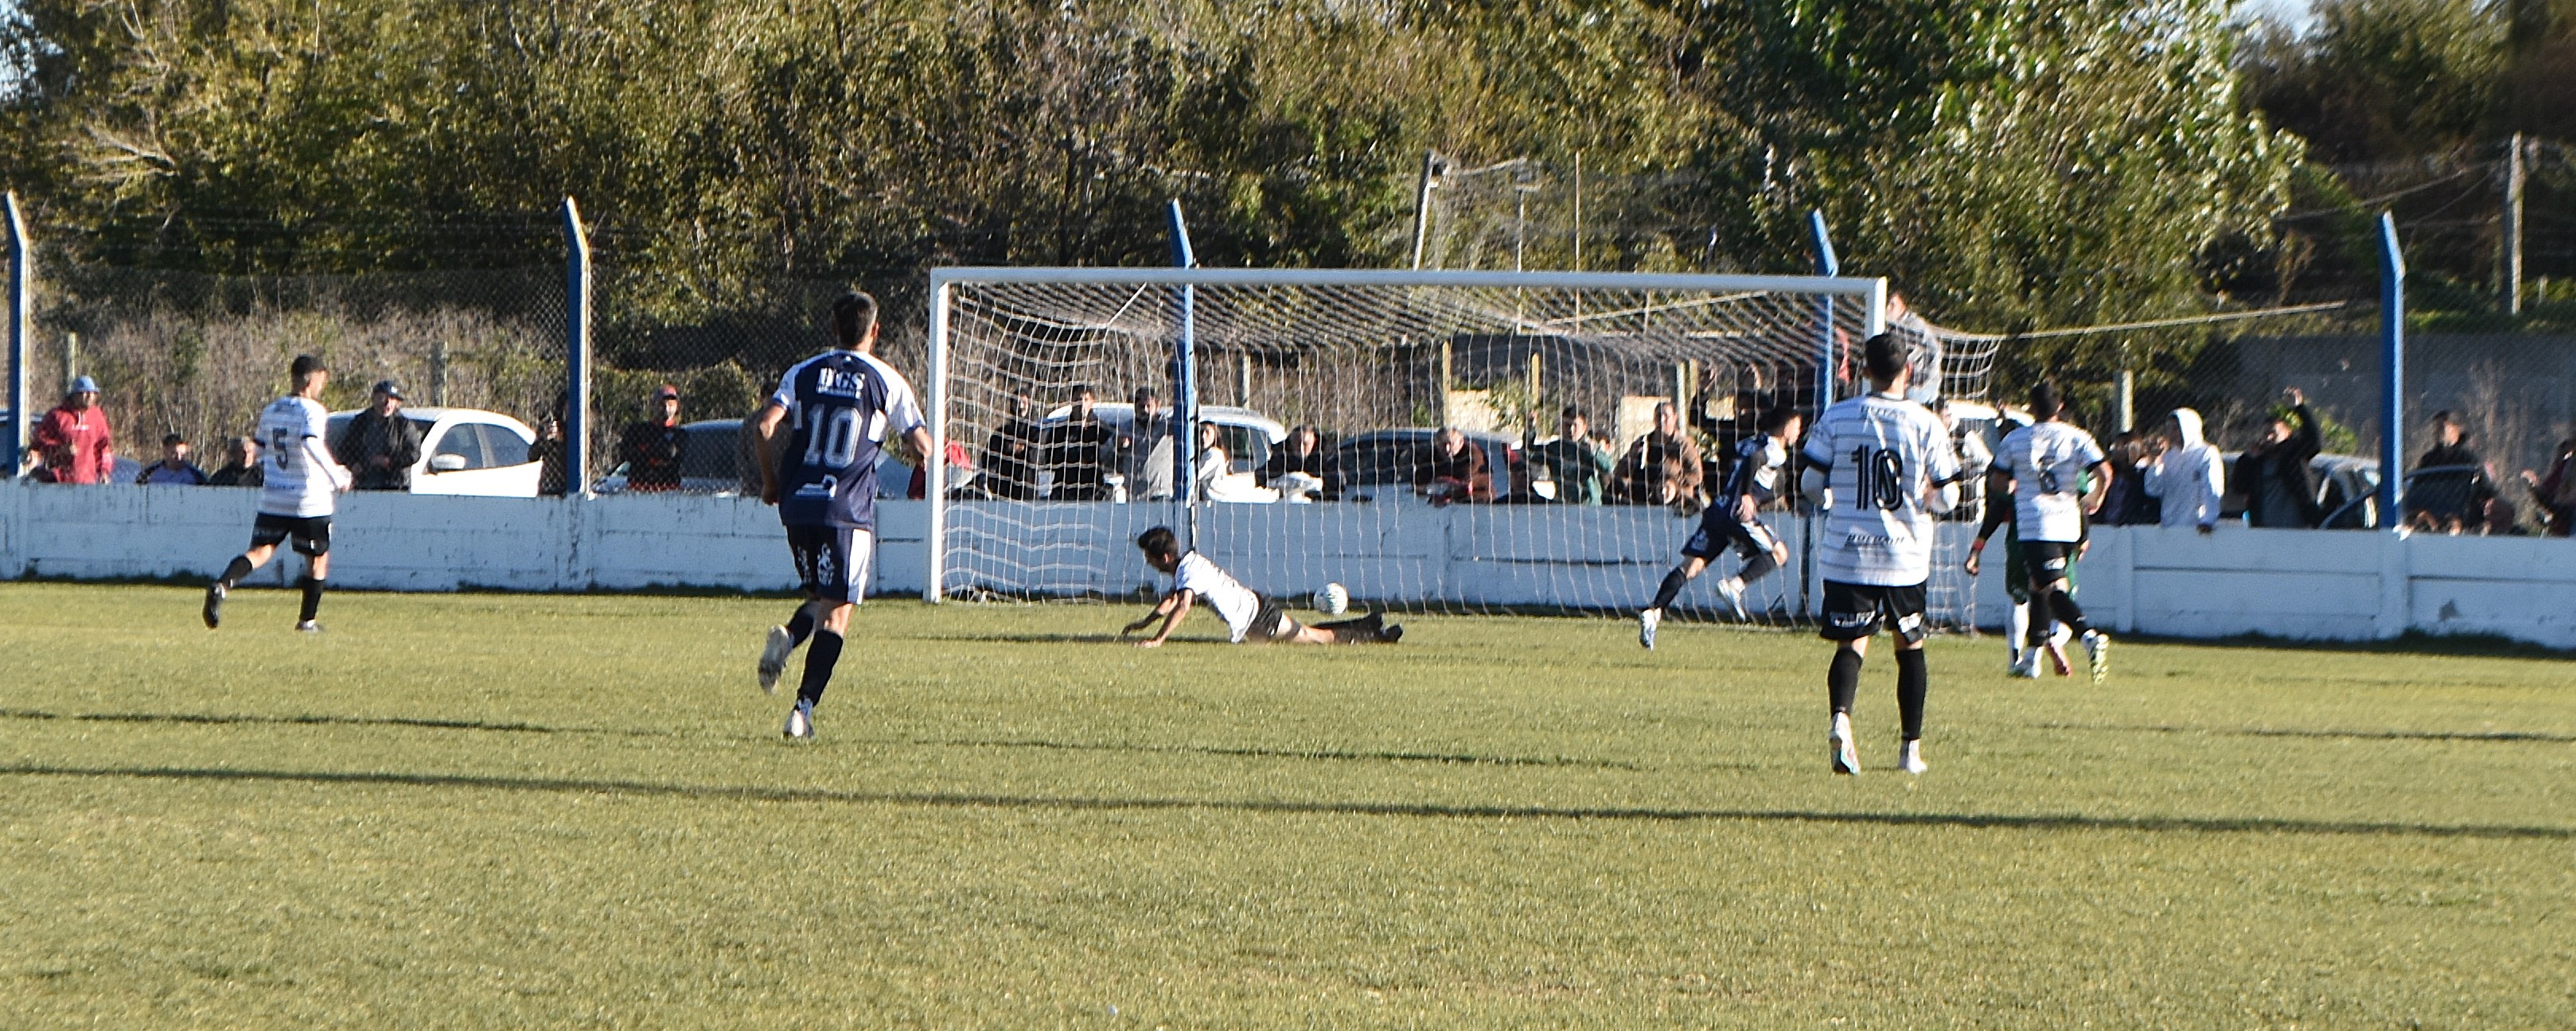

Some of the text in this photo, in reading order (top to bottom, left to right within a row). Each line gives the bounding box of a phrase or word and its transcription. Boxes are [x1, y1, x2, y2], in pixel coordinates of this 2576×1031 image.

[272, 426, 289, 470] 5
[804, 403, 862, 469] 10
[1851, 443, 1904, 512] 10
